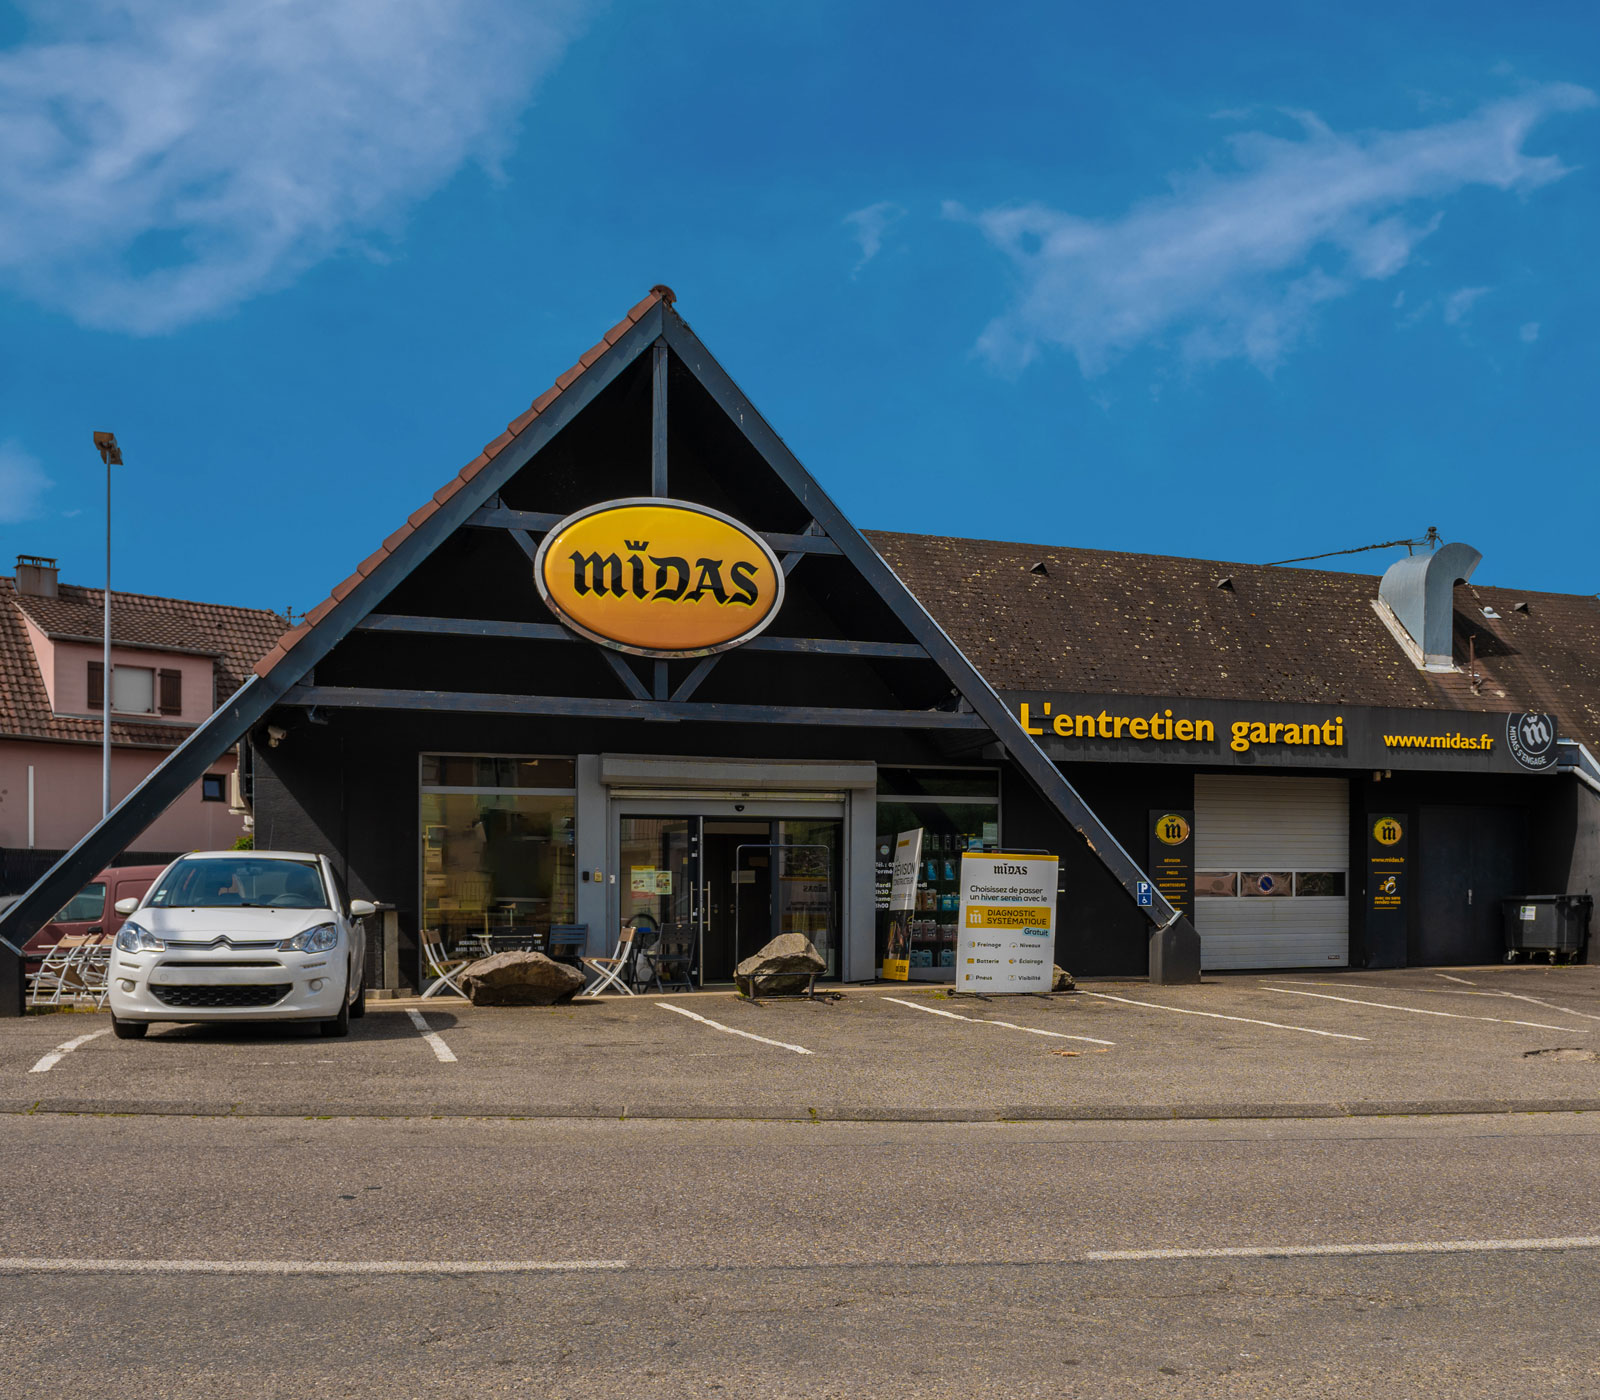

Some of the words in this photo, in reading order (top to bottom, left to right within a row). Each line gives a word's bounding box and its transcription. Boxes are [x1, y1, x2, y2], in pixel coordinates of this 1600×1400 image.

[1020, 702, 1215, 742] L'entretien
[1230, 716, 1344, 752] garanti
[1383, 732, 1494, 750] www.midas.fr
[1509, 725, 1520, 750] MIDAS
[1516, 749, 1547, 765] S'ENGAGE
[970, 885, 1008, 893] Choisissez
[1008, 886, 1018, 894] de
[1140, 883, 1148, 893] P
[981, 893, 999, 901] hiver
[987, 909, 1036, 917] DIAGNOSTIC
[986, 917, 1047, 925] SYSTÉMATIQUE
[1024, 928, 1049, 937] Gratuit
[1019, 958, 1044, 966] Éclairage
